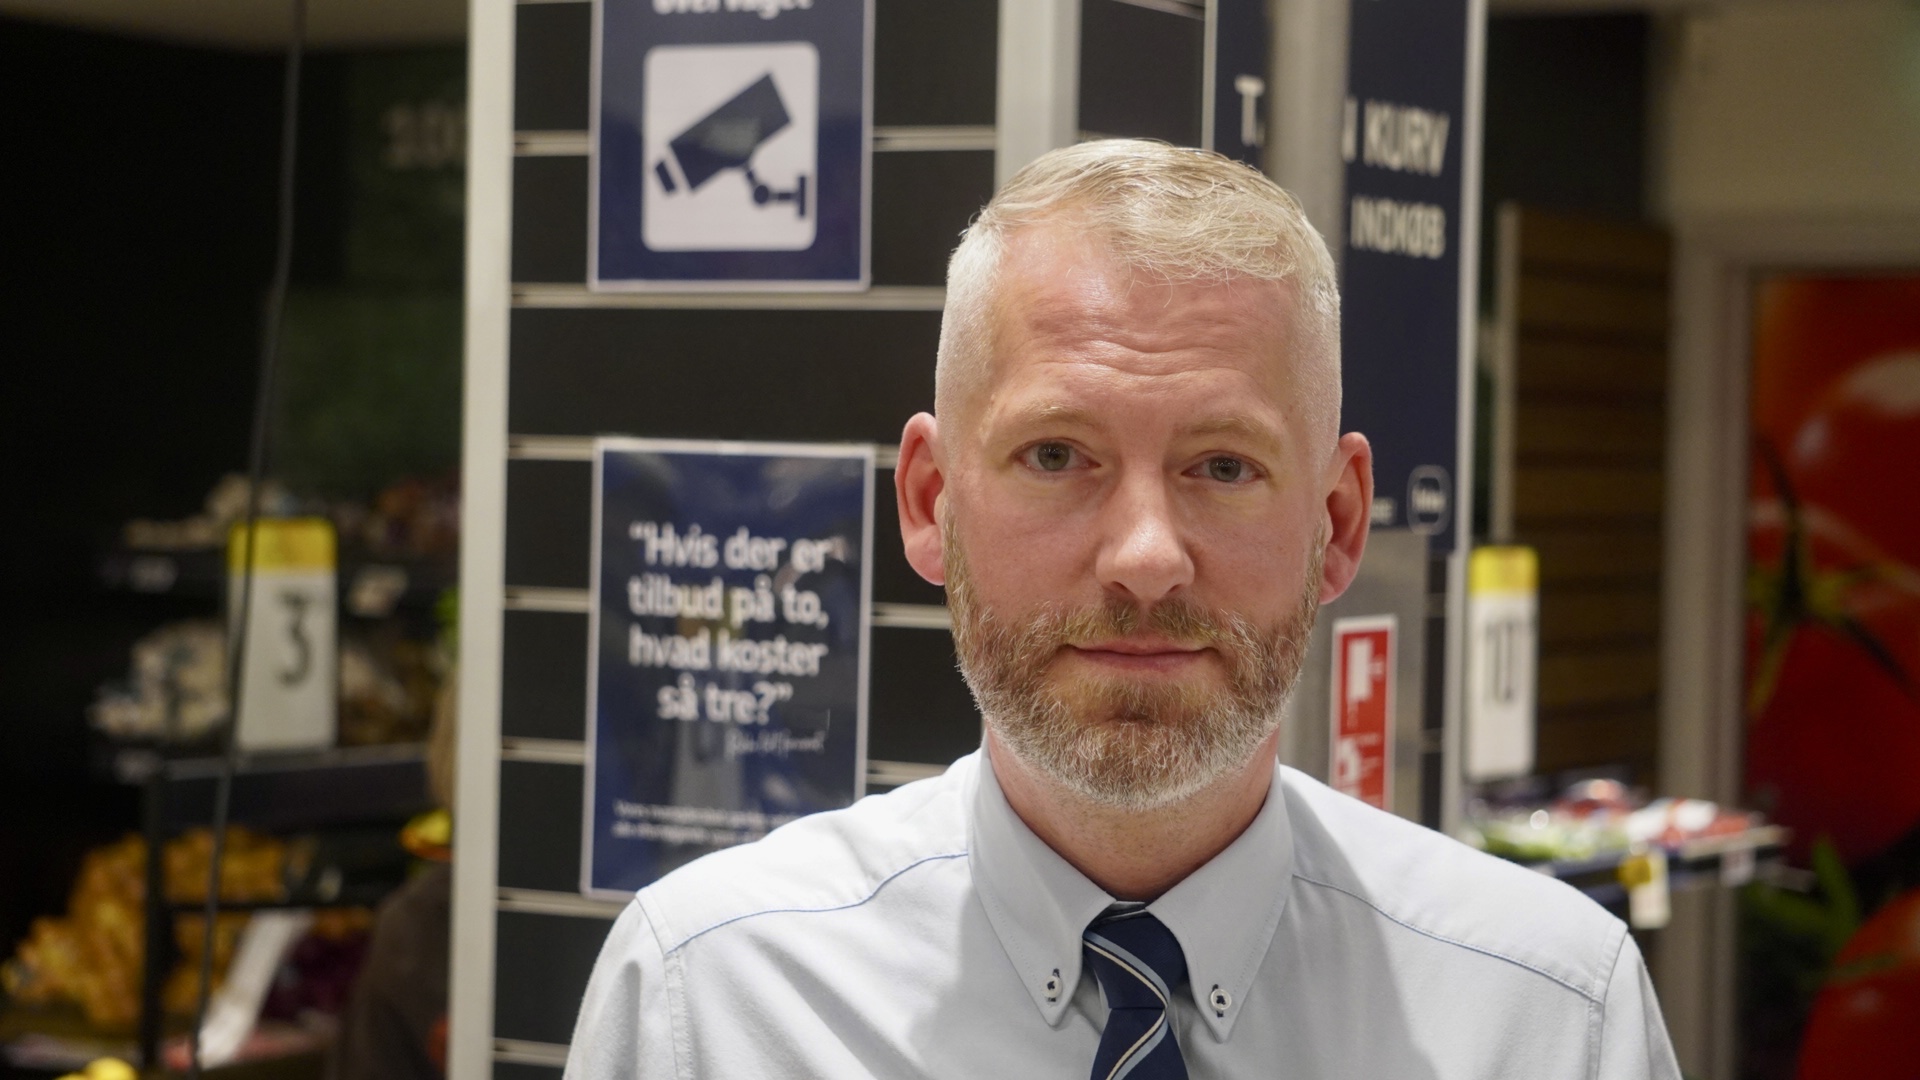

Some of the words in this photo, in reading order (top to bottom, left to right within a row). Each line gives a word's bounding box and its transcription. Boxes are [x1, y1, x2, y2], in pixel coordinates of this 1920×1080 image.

[1363, 98, 1449, 177] KURV
[723, 526, 787, 570] der
[791, 537, 833, 573] er
[628, 573, 724, 620] tilbud
[730, 573, 775, 629] på
[781, 581, 829, 630] to,
[628, 622, 711, 669] hvad
[717, 627, 829, 677] koster
[657, 672, 699, 721] så
